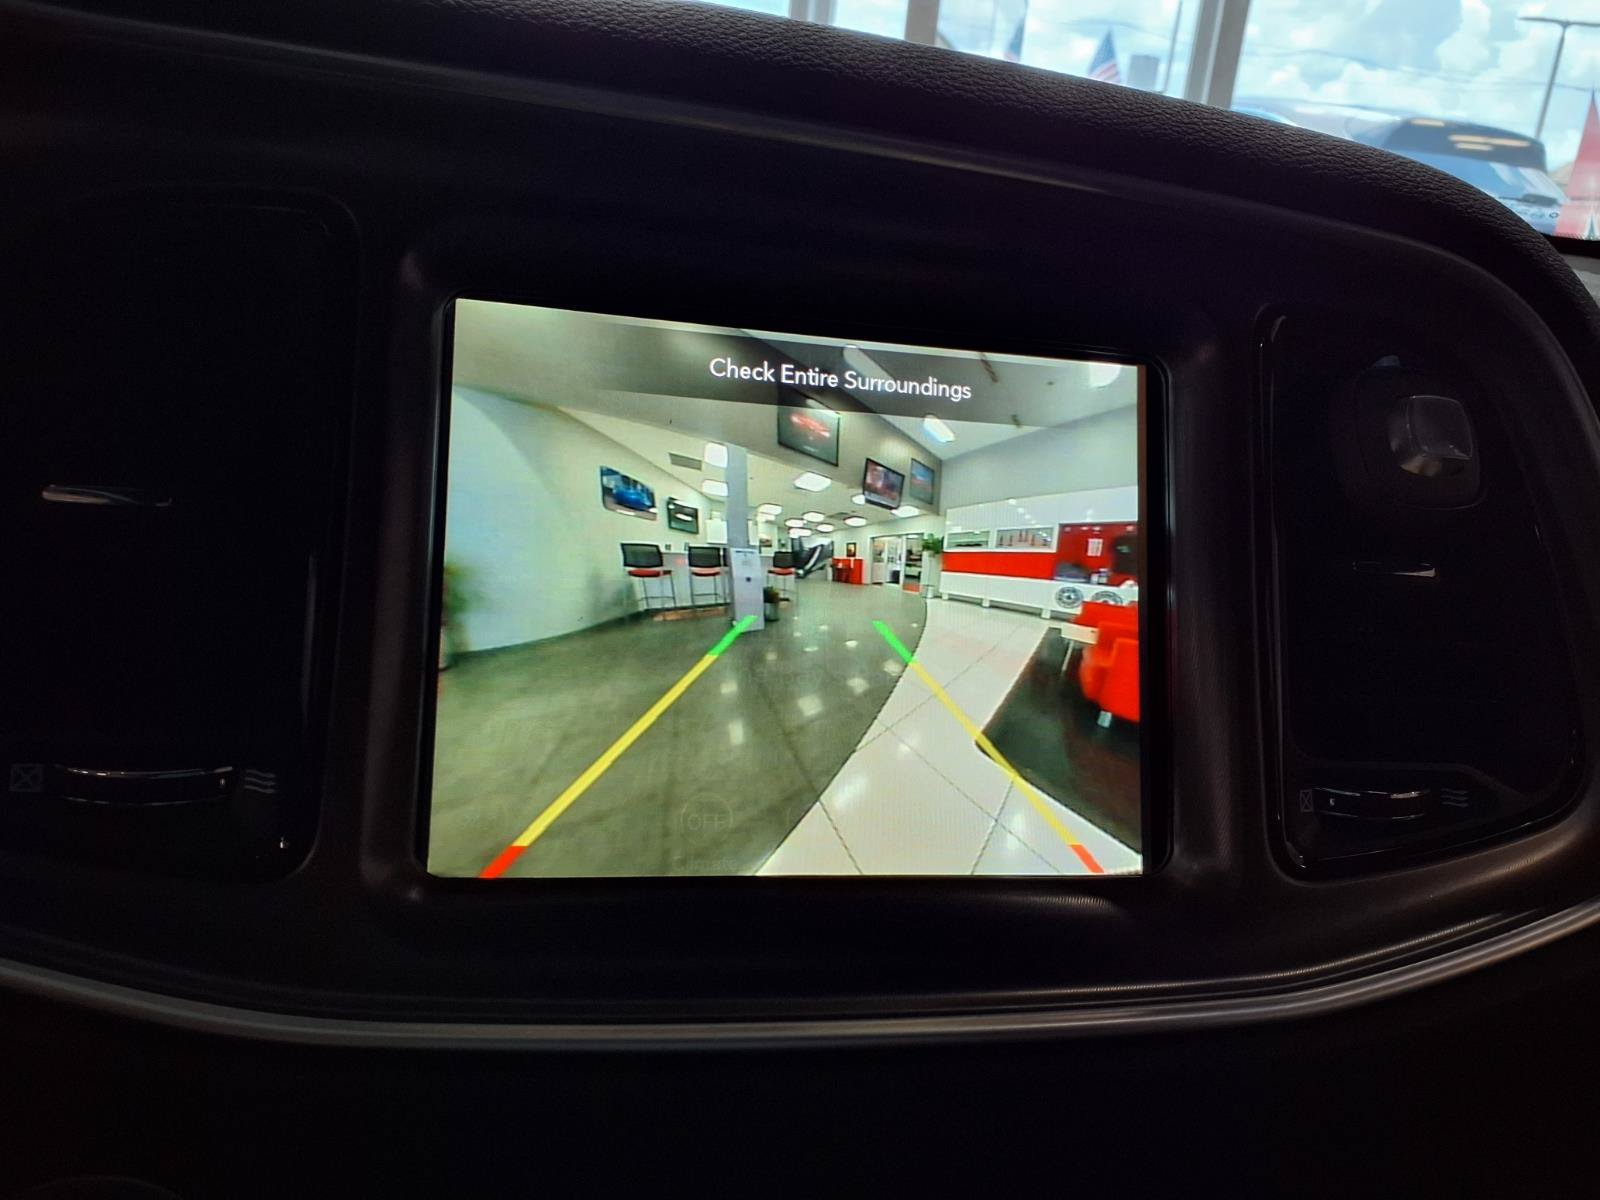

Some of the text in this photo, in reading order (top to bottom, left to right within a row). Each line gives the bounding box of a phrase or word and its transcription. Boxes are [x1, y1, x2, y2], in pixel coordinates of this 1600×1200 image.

[709, 357, 972, 401] Check Entire Surroundings
[687, 813, 725, 831] OFF
